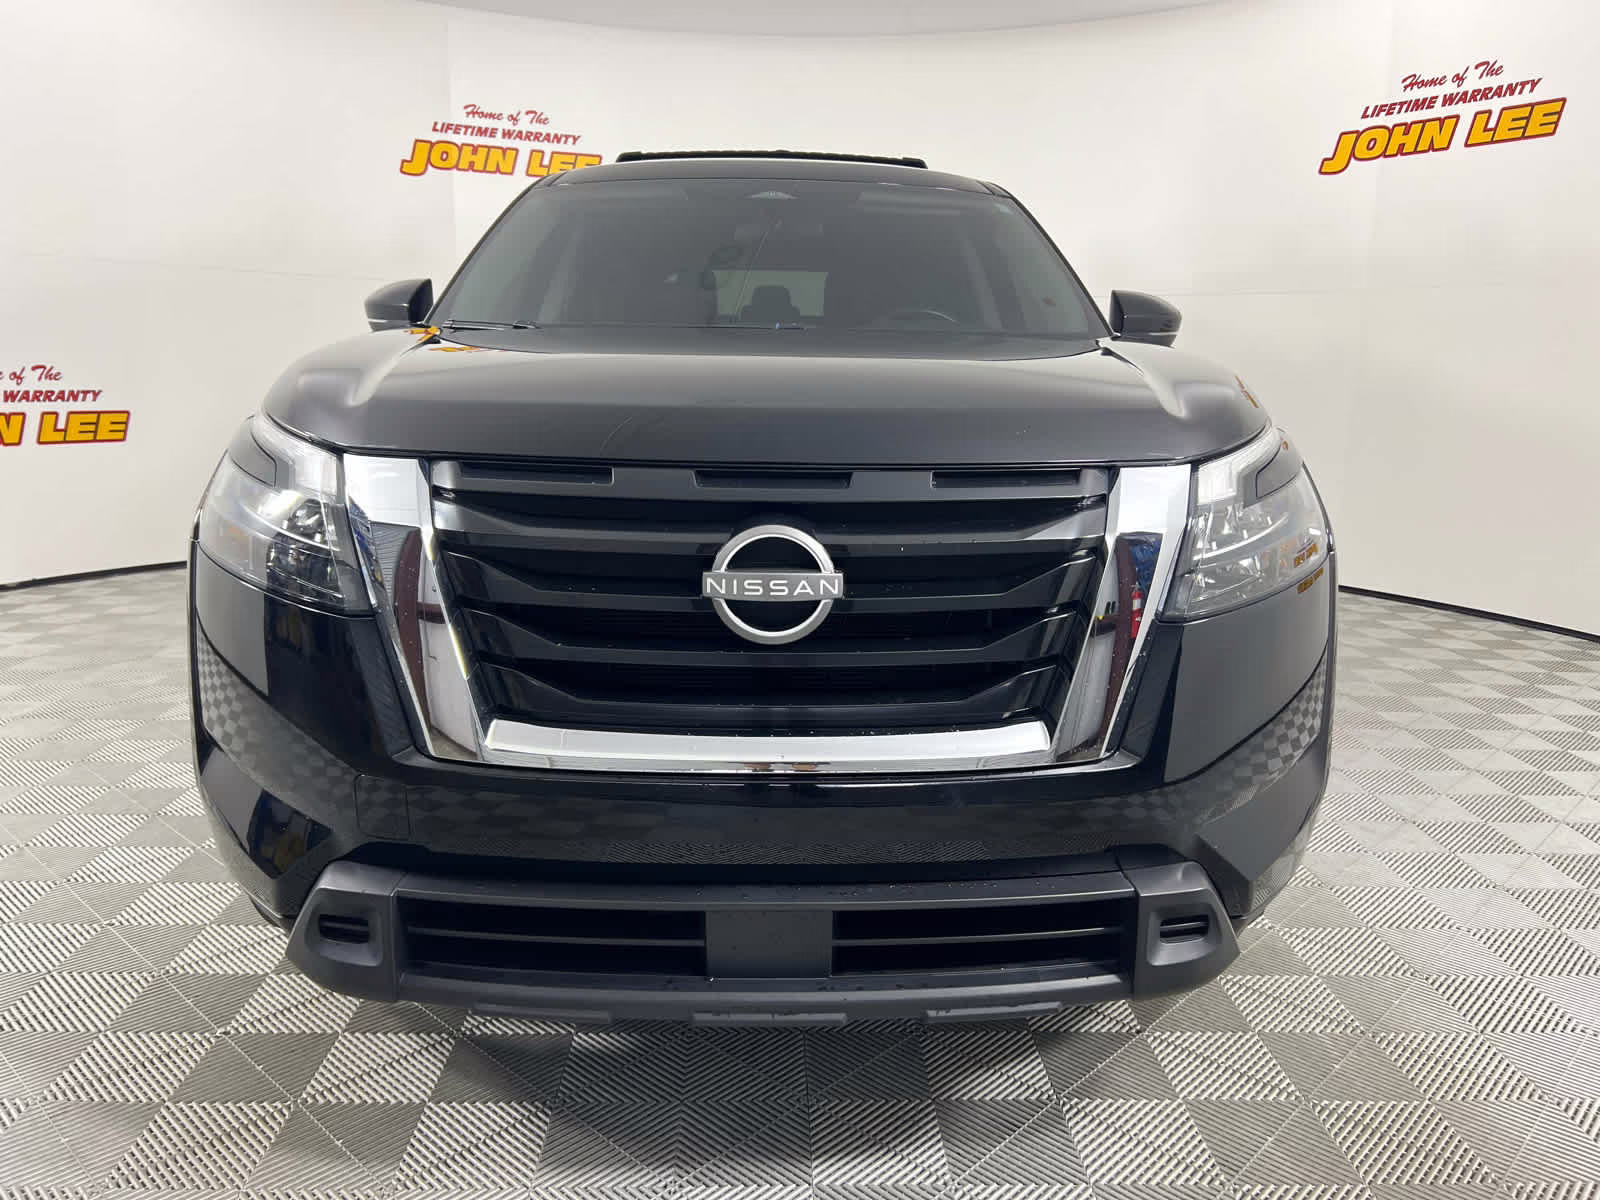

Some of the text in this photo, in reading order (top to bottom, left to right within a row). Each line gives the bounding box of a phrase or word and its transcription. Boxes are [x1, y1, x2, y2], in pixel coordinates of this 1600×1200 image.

[1401, 59, 1504, 93] Home of The
[1361, 77, 1543, 119] LIFETIME WARRANTY
[463, 103, 550, 125] Home of The
[431, 121, 581, 145] LIFETIME WARRANTY
[1318, 97, 1568, 175] JOHN LEE
[399, 138, 519, 177] JOHN
[9, 366, 25, 386] of
[31, 365, 62, 381] The
[3, 389, 103, 403] WARRANTY
[36, 410, 131, 445] LEE
[706, 577, 839, 596] NISSAN
